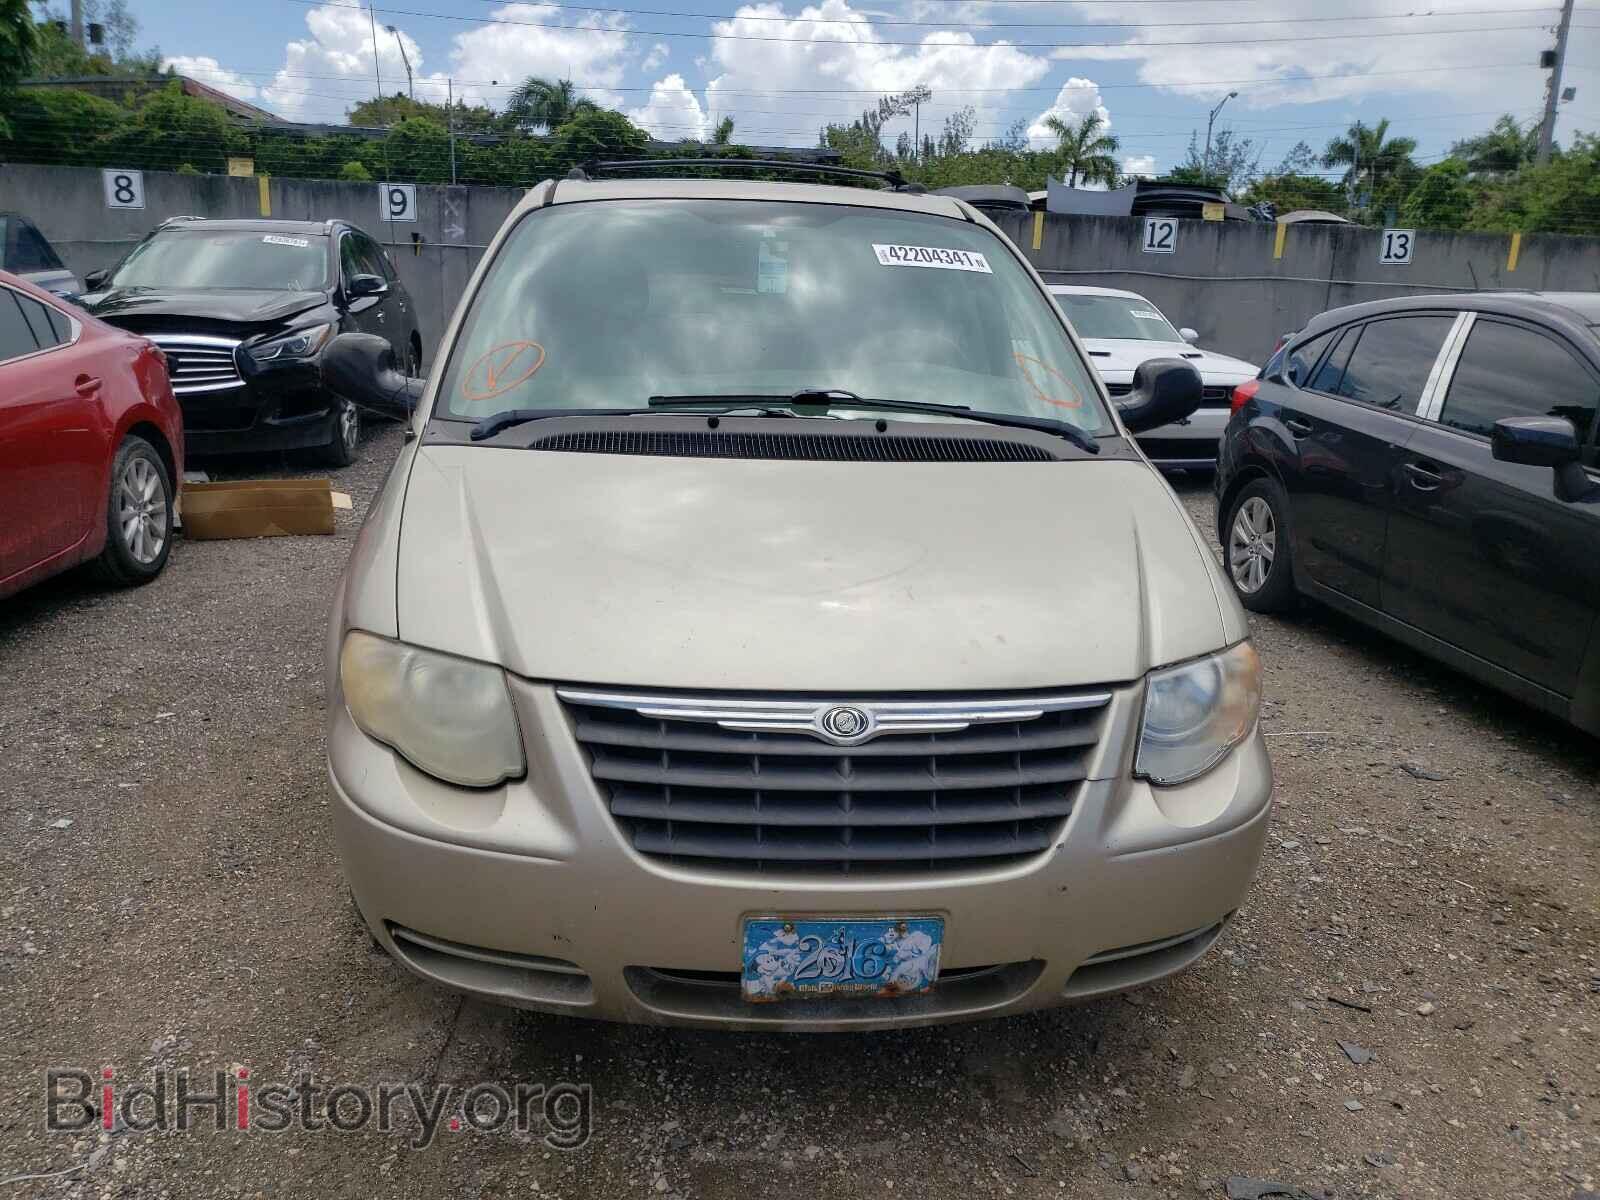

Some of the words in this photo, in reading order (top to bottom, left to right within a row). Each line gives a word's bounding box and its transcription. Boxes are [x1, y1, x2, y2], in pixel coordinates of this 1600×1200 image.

[114, 175, 135, 203] 8
[389, 188, 407, 217] 9
[1147, 221, 1173, 249] 12
[1383, 233, 1409, 259] 13
[889, 246, 974, 267] 42204341
